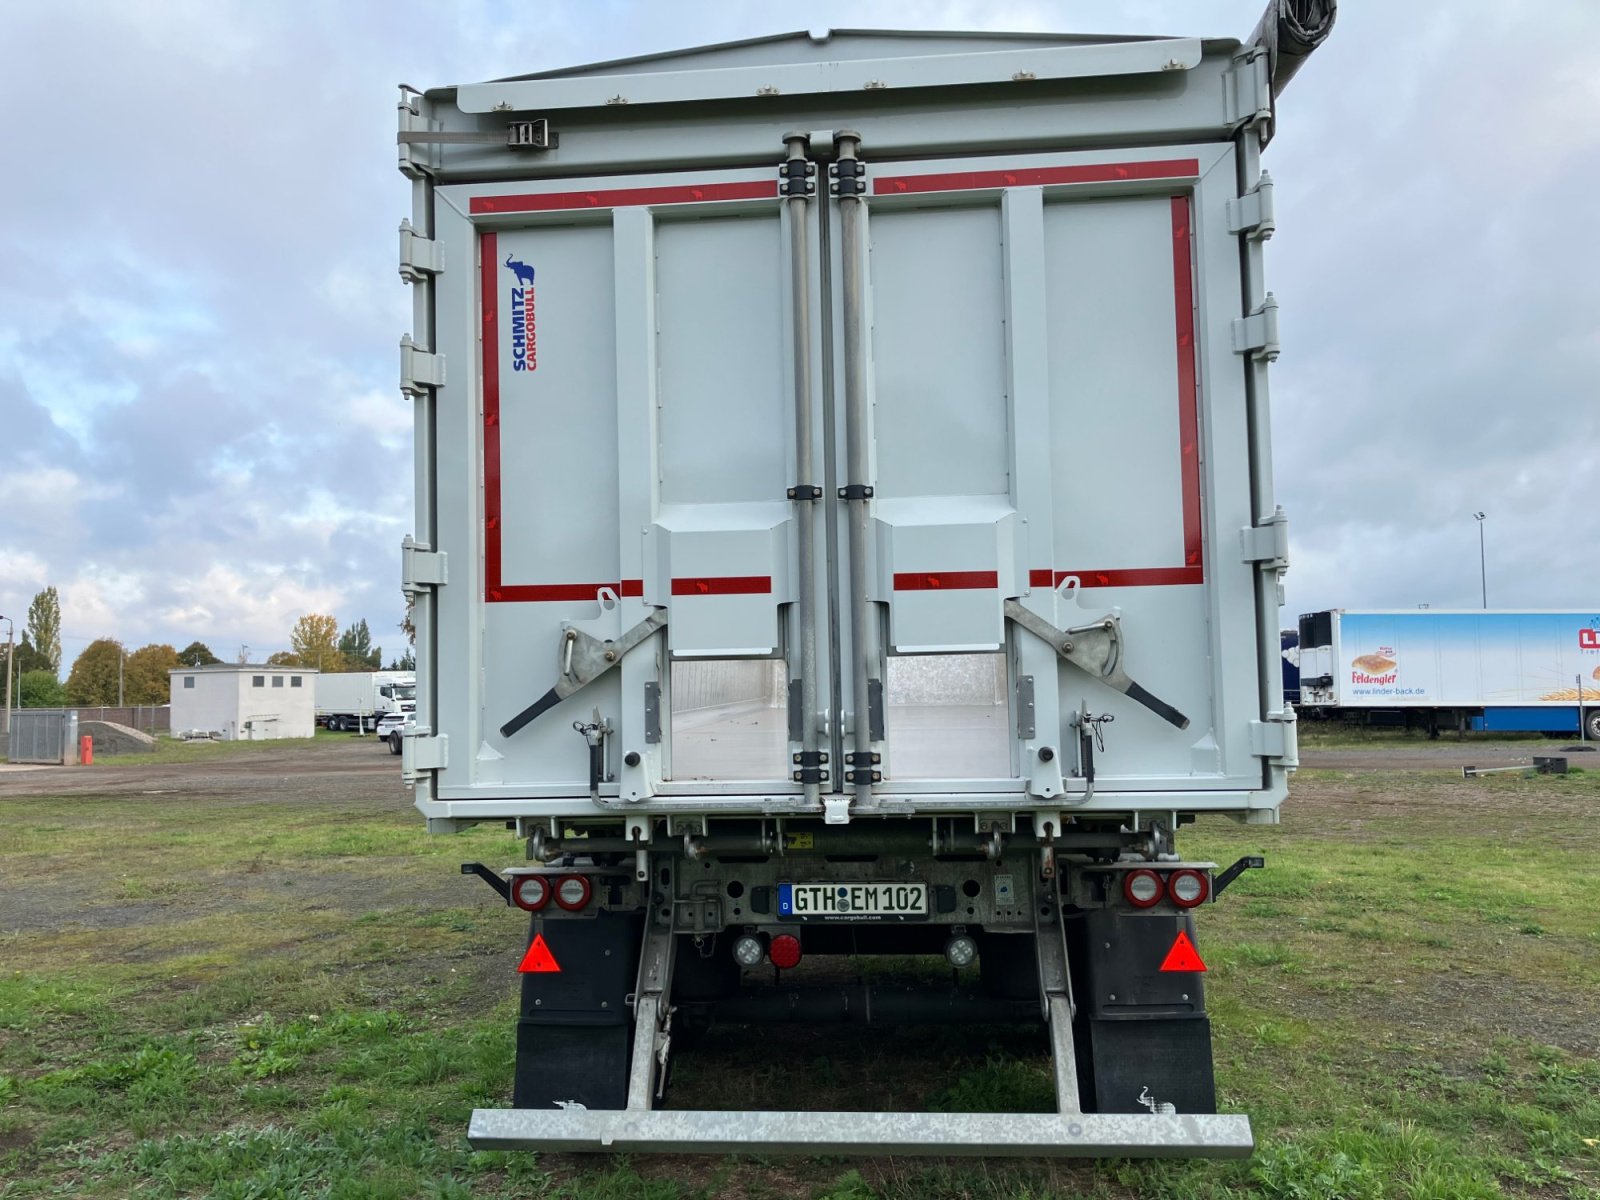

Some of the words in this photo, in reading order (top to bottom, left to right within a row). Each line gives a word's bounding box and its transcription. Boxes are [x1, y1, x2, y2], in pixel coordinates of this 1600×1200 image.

[512, 287, 526, 371] SCHMITZ
[525, 287, 537, 371] CARGOBULL
[1352, 687, 1425, 695] www.linder-back.de
[794, 887, 836, 911] GTH
